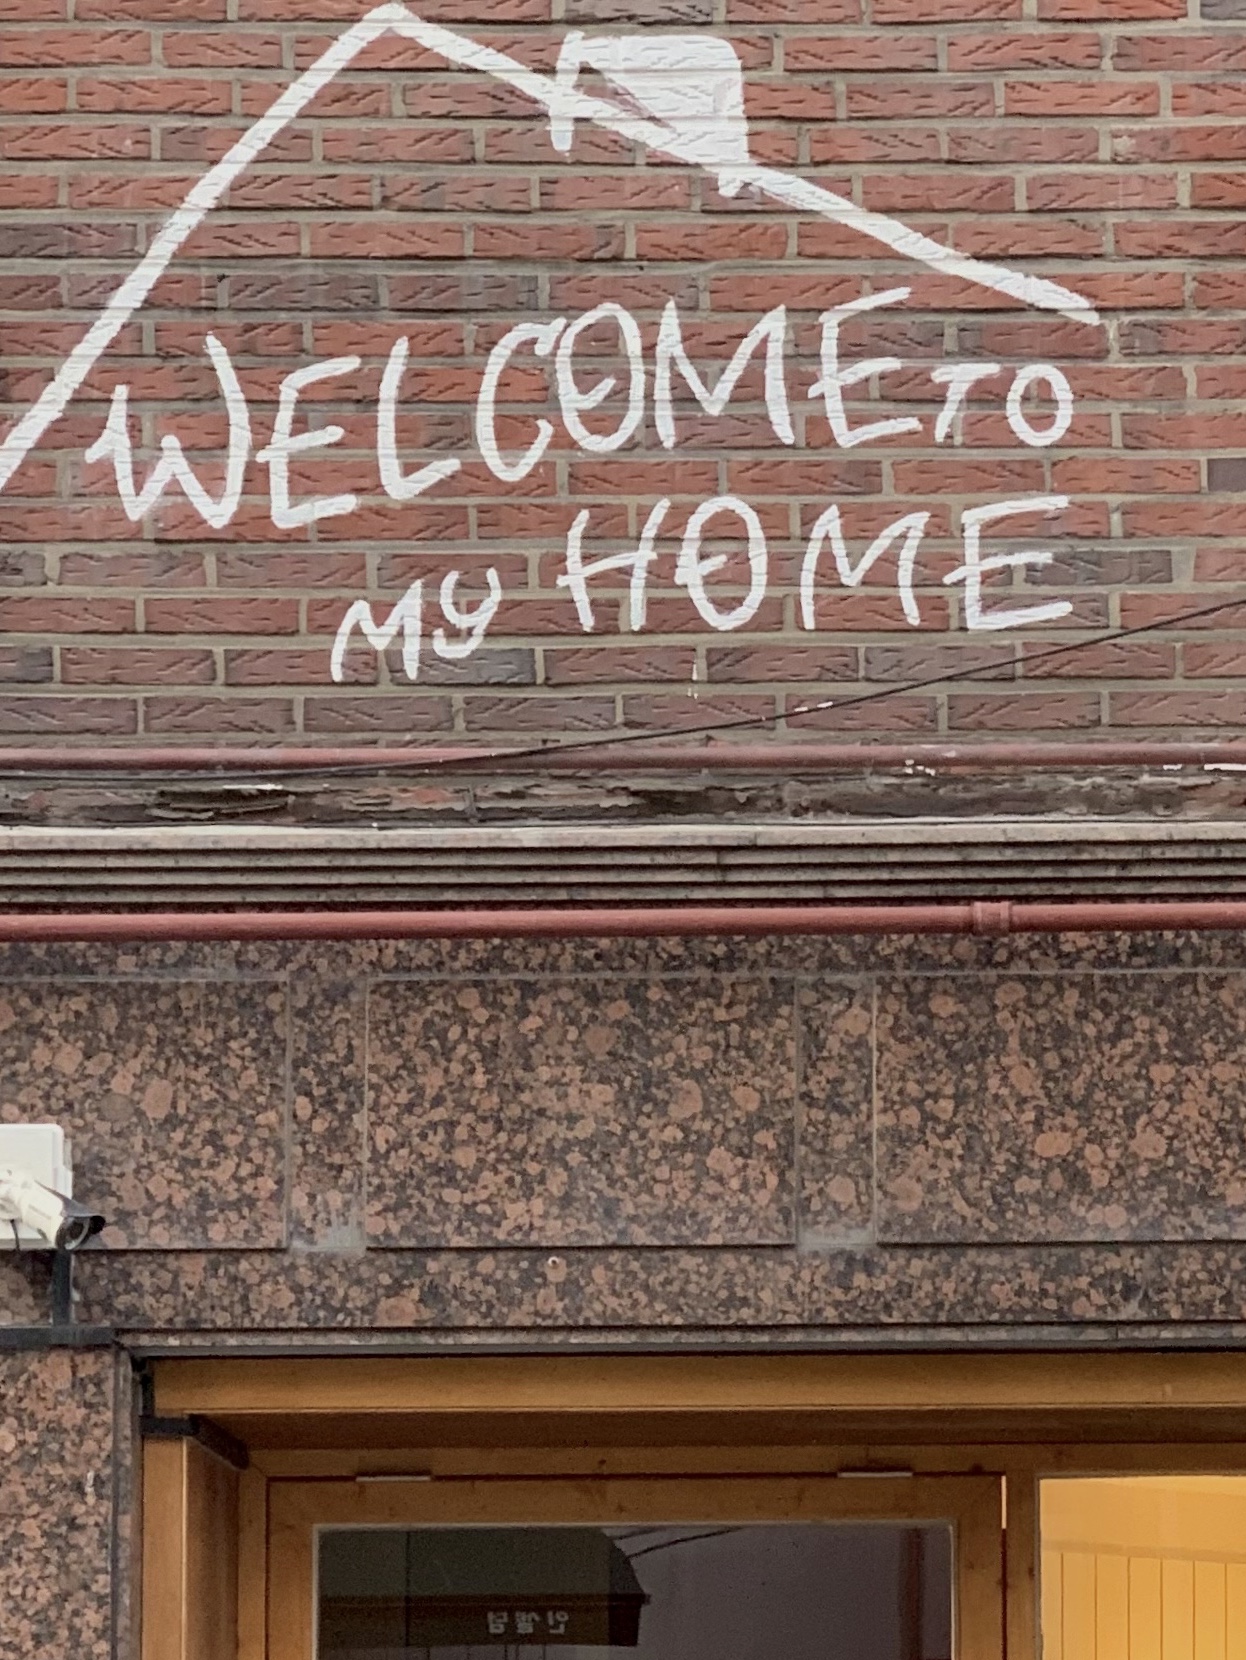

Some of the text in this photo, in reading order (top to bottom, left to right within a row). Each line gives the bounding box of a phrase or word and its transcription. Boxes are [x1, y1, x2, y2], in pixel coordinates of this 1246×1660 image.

[85, 286, 1074, 530] WELCOME TO
[557, 495, 1074, 632] HOME
